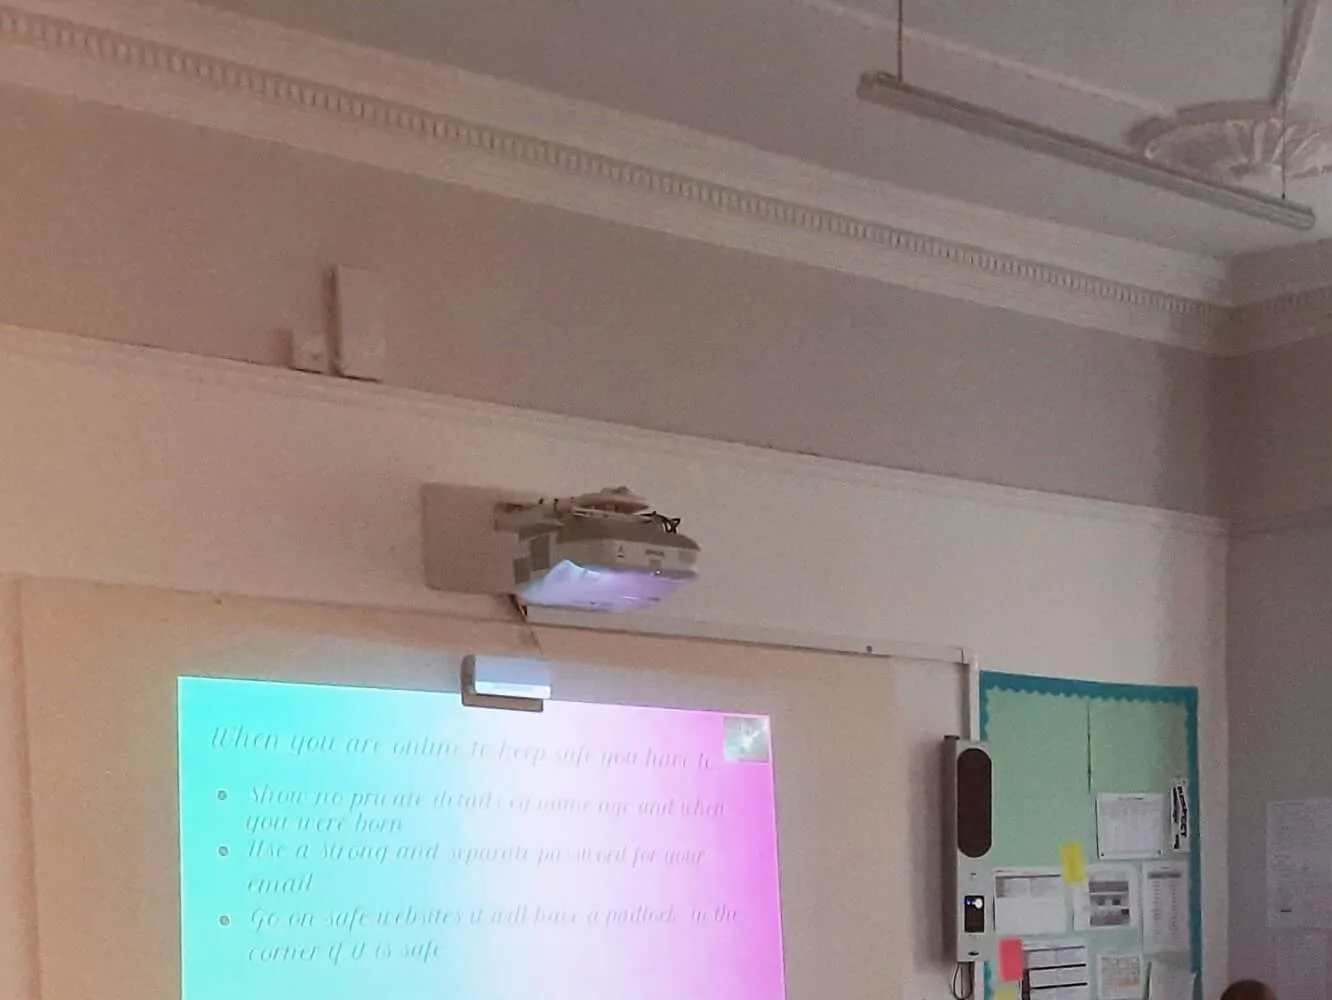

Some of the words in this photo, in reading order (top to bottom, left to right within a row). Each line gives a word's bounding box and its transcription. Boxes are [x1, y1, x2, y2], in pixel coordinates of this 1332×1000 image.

[210, 725, 279, 749] When
[290, 734, 335, 758] you
[345, 737, 381, 753] are
[314, 790, 343, 805] no
[246, 814, 288, 834] you
[296, 815, 345, 833] were
[354, 813, 403, 834] born
[249, 838, 283, 861] Use
[295, 844, 310, 860] a
[320, 840, 389, 865] strong
[396, 842, 439, 861] and
[247, 873, 314, 894] email
[250, 906, 280, 931] Go
[288, 914, 315, 928] on
[324, 905, 368, 933] safe
[248, 943, 321, 962] corner
